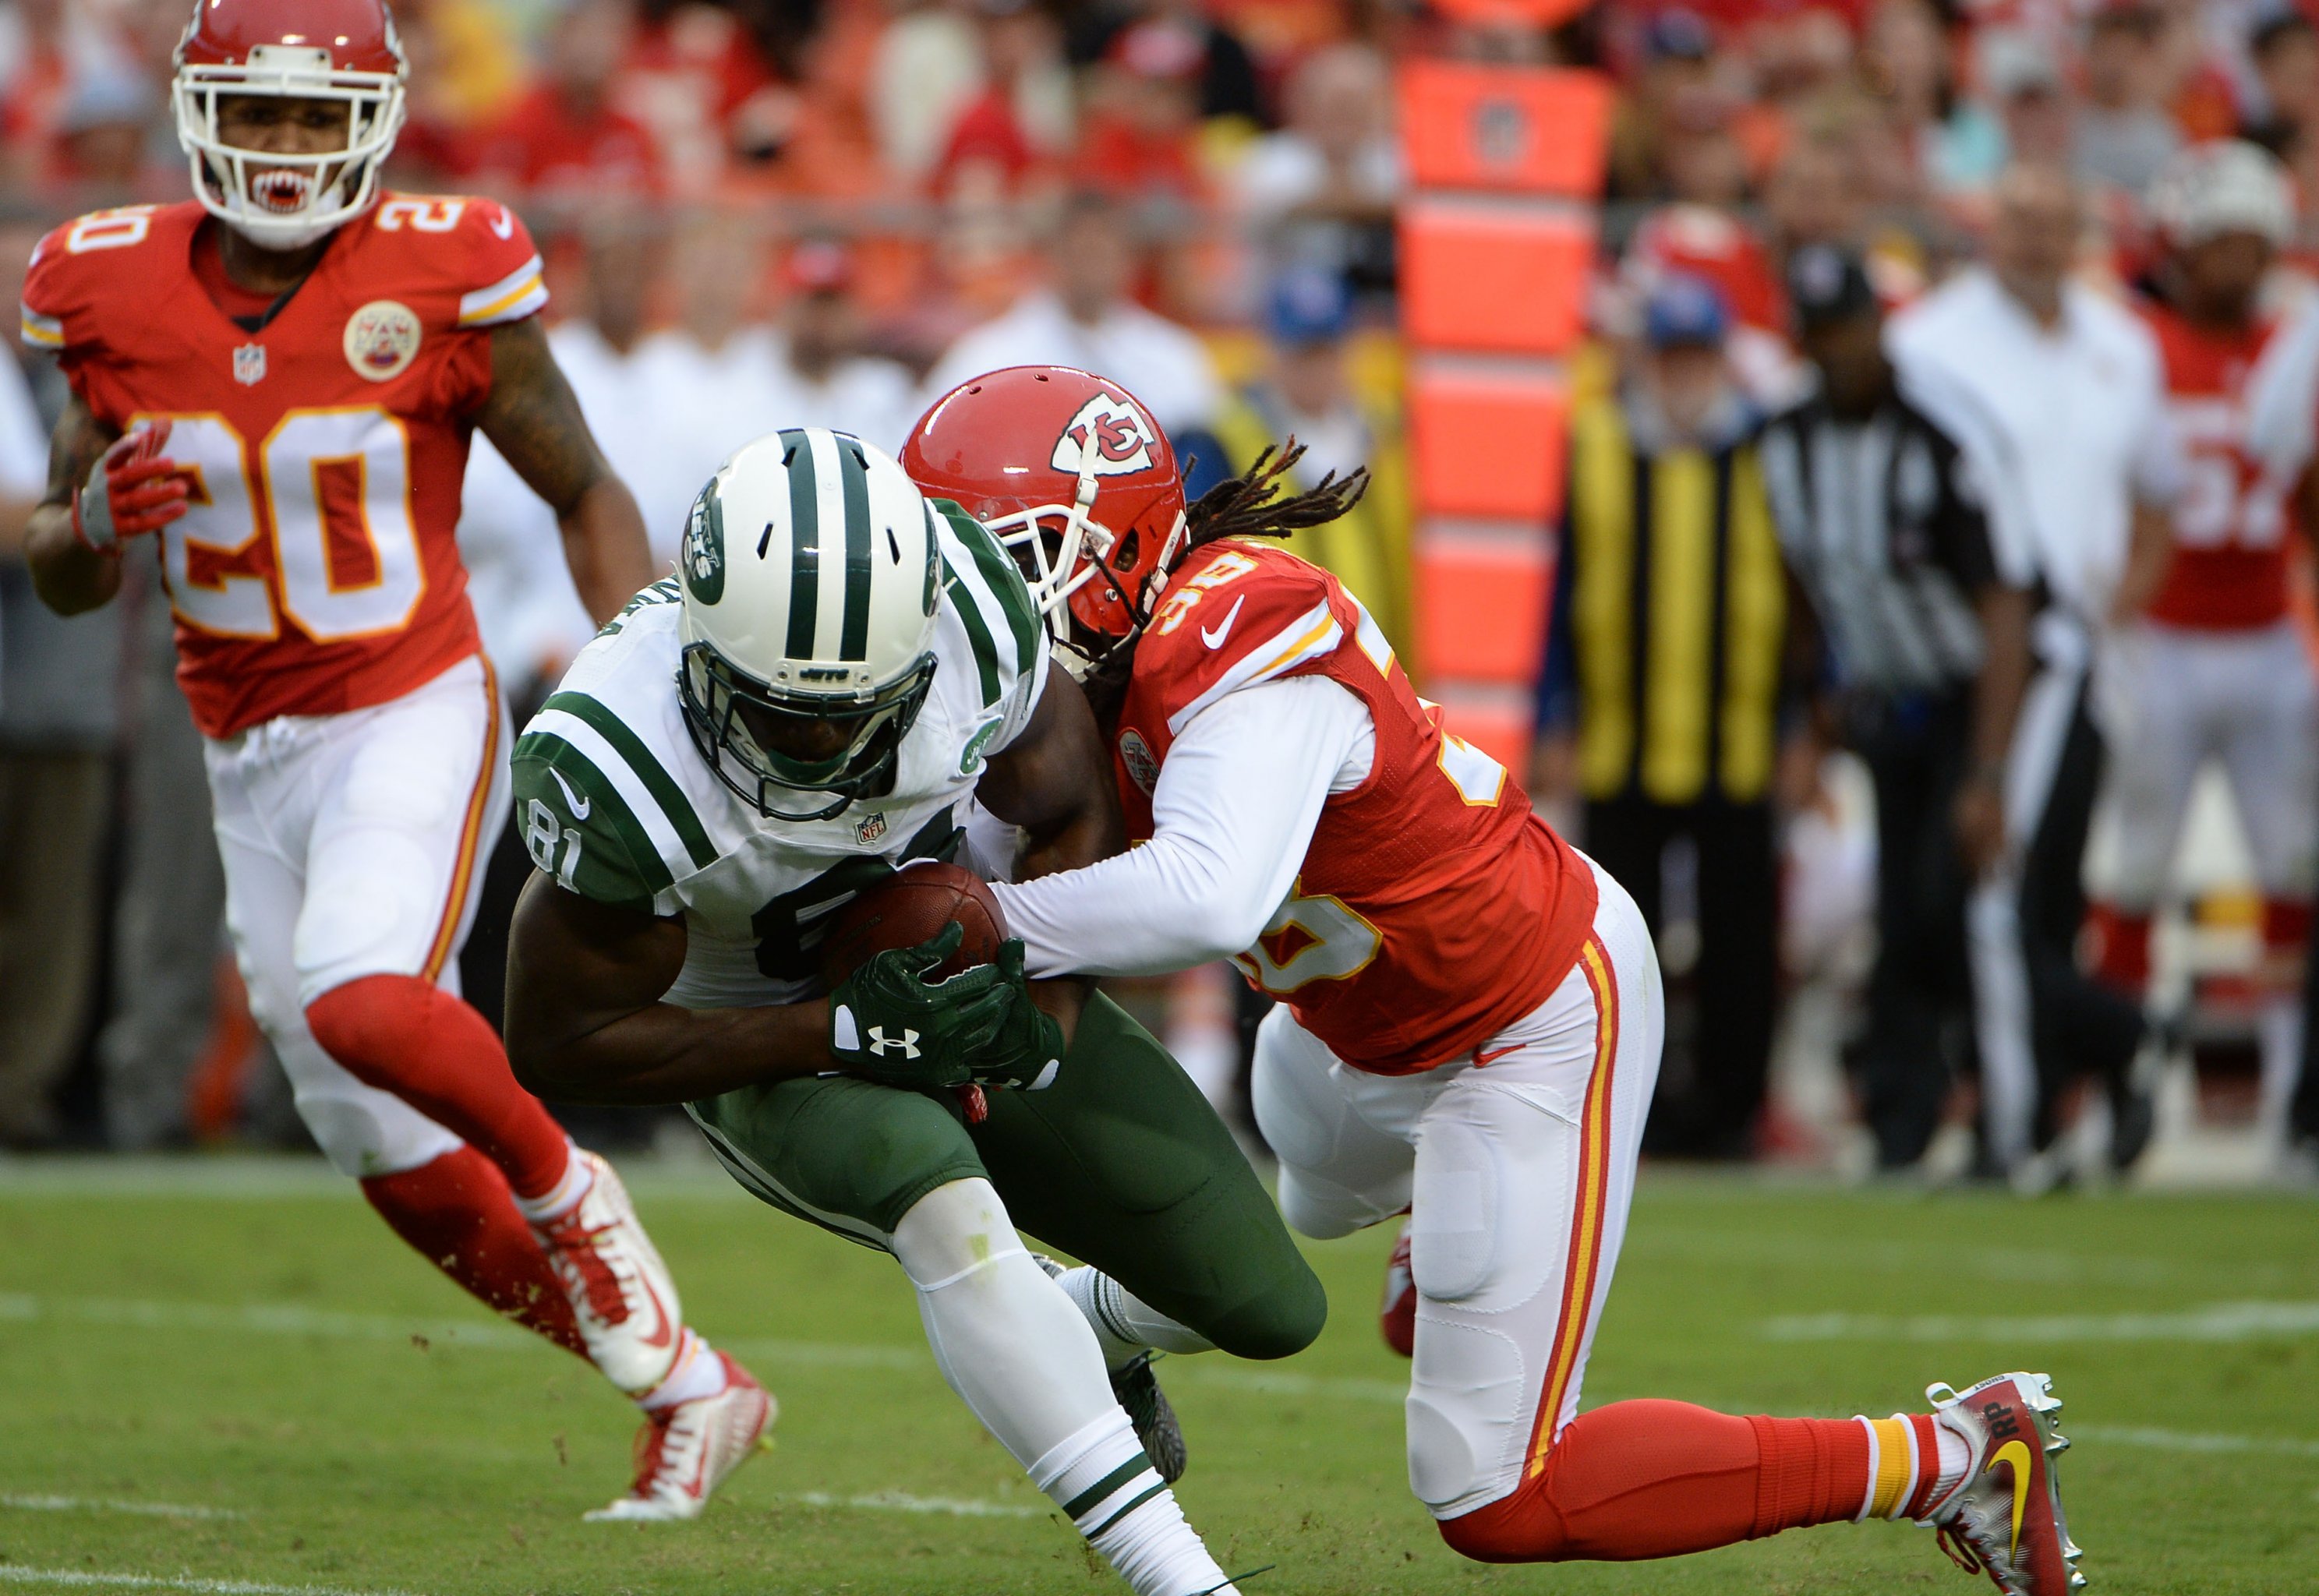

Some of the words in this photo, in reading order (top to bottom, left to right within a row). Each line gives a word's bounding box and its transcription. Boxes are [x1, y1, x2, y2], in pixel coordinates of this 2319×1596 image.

[1067, 411, 1144, 462] KC
[126, 403, 427, 645] 20
[526, 798, 582, 895] 81
[861, 823, 884, 840] NFL
[1984, 1401, 2020, 1439] RP
